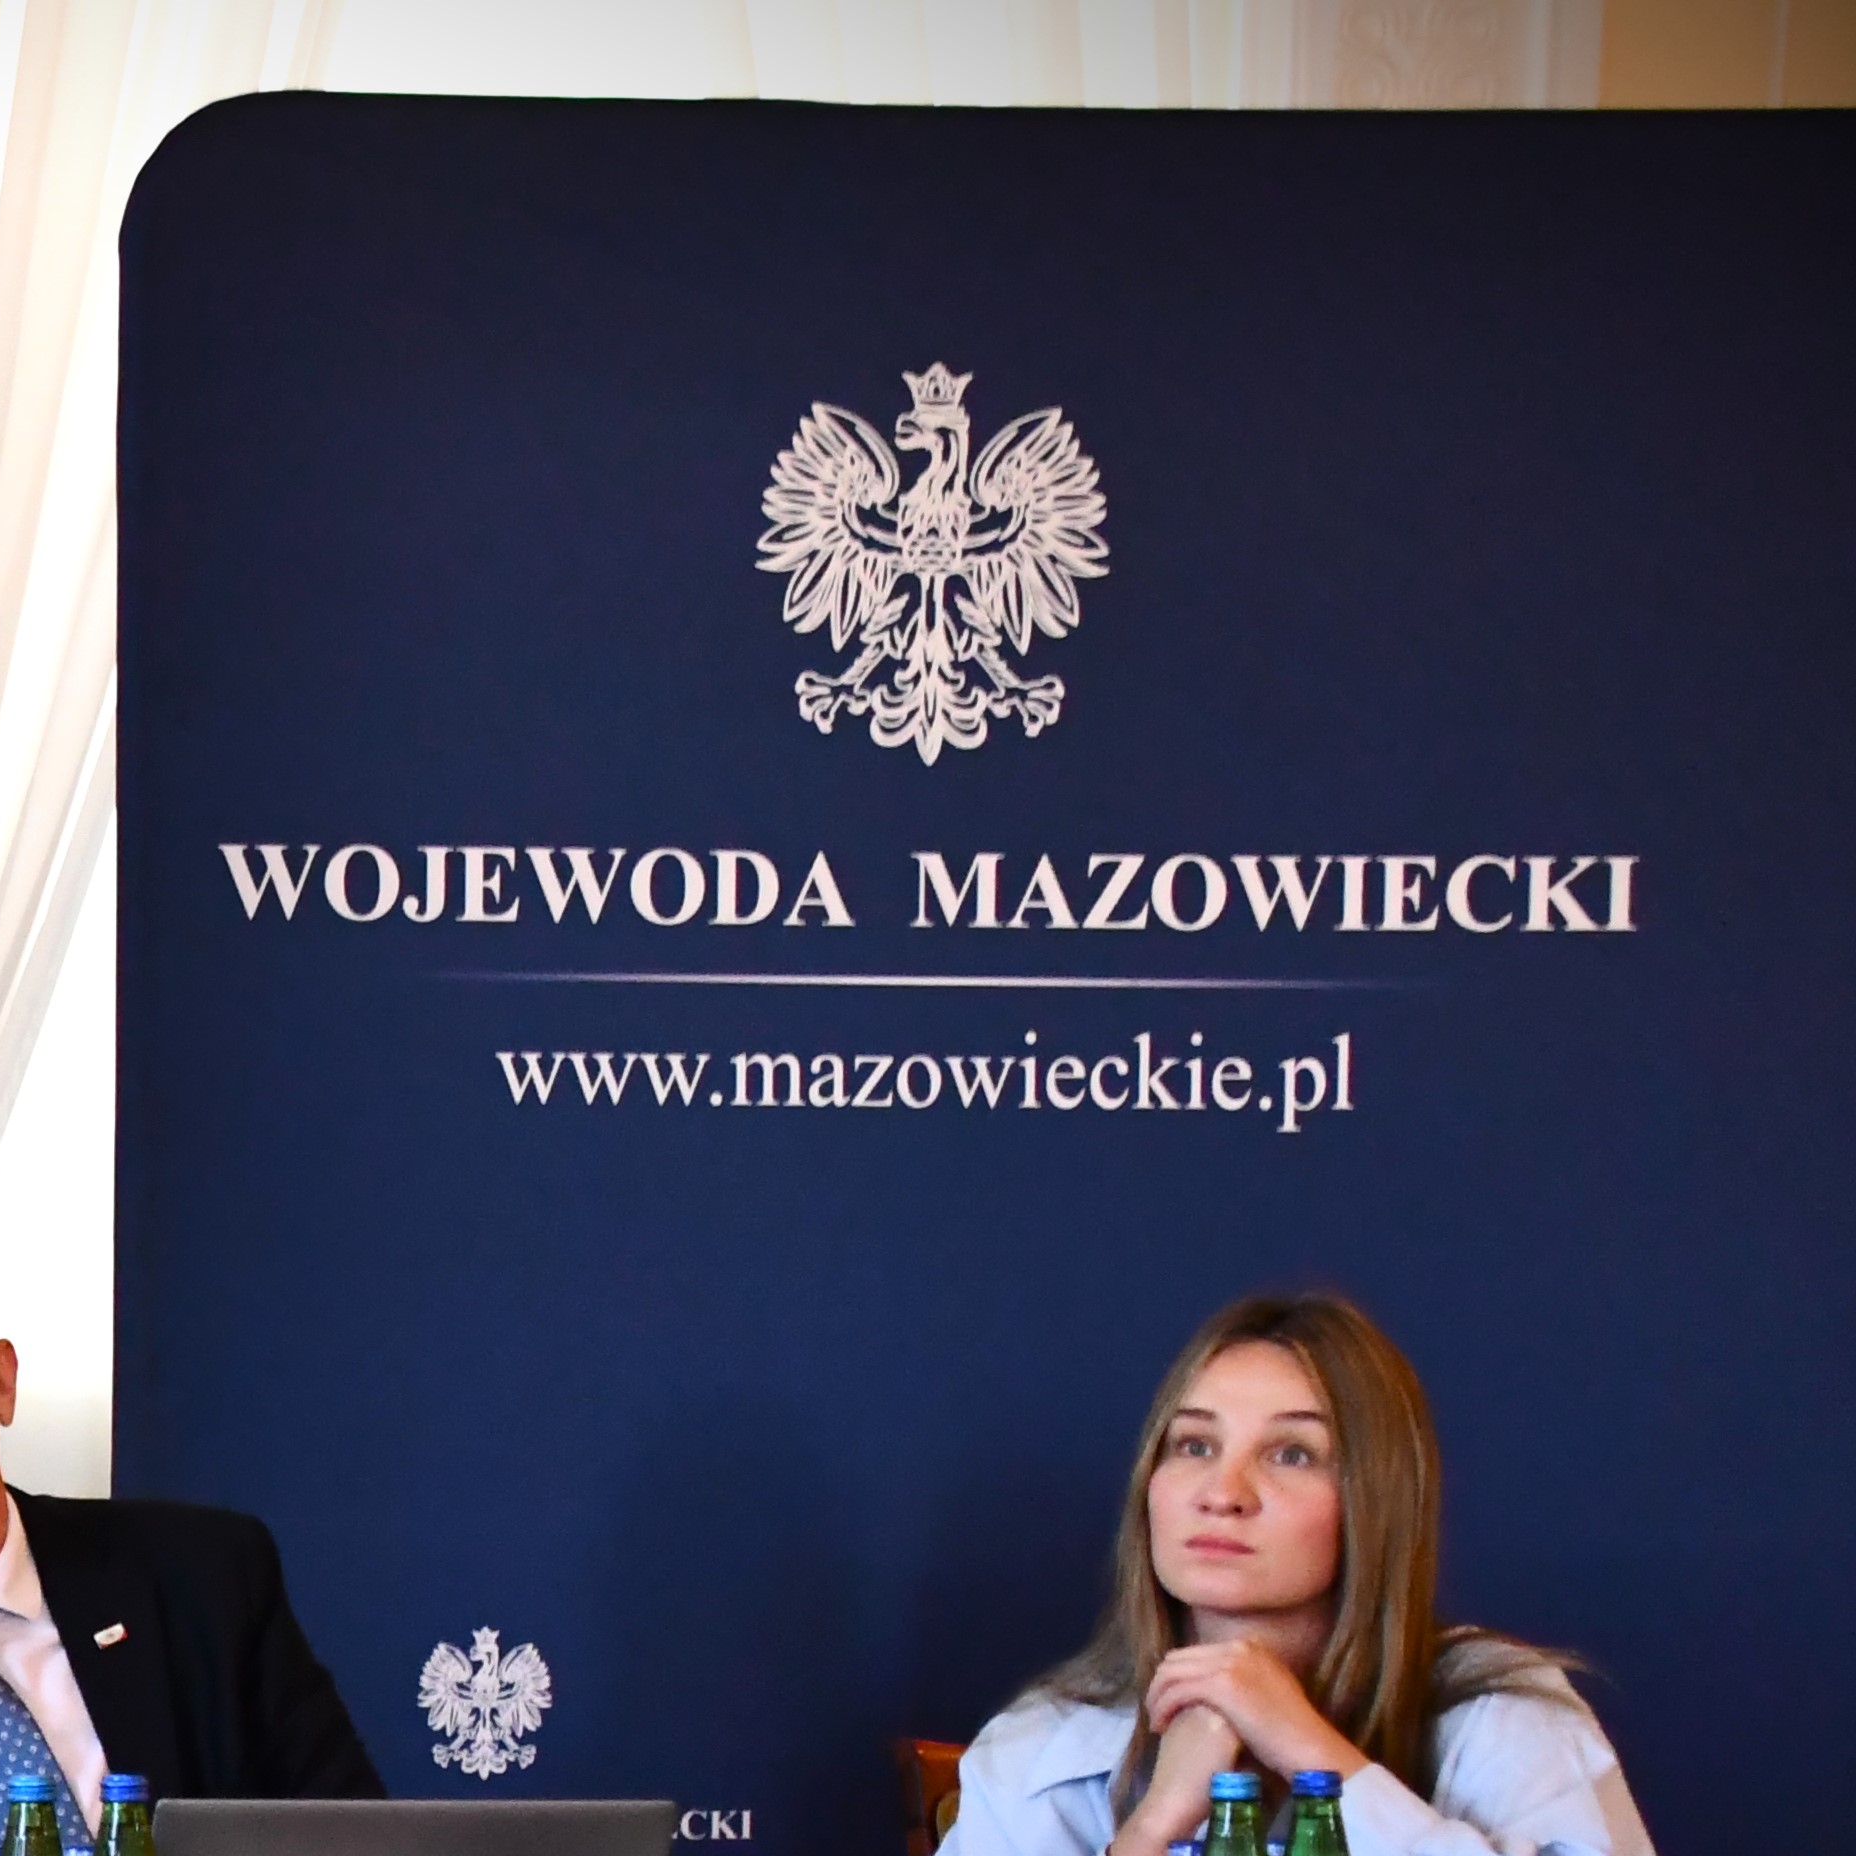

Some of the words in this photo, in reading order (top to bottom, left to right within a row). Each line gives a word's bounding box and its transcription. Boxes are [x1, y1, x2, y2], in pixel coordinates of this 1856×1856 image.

[219, 844, 855, 926] WOJEWODA
[911, 853, 1638, 932] MAZOWIECKI
[496, 1031, 1353, 1132] www.mazowieckie.pl
